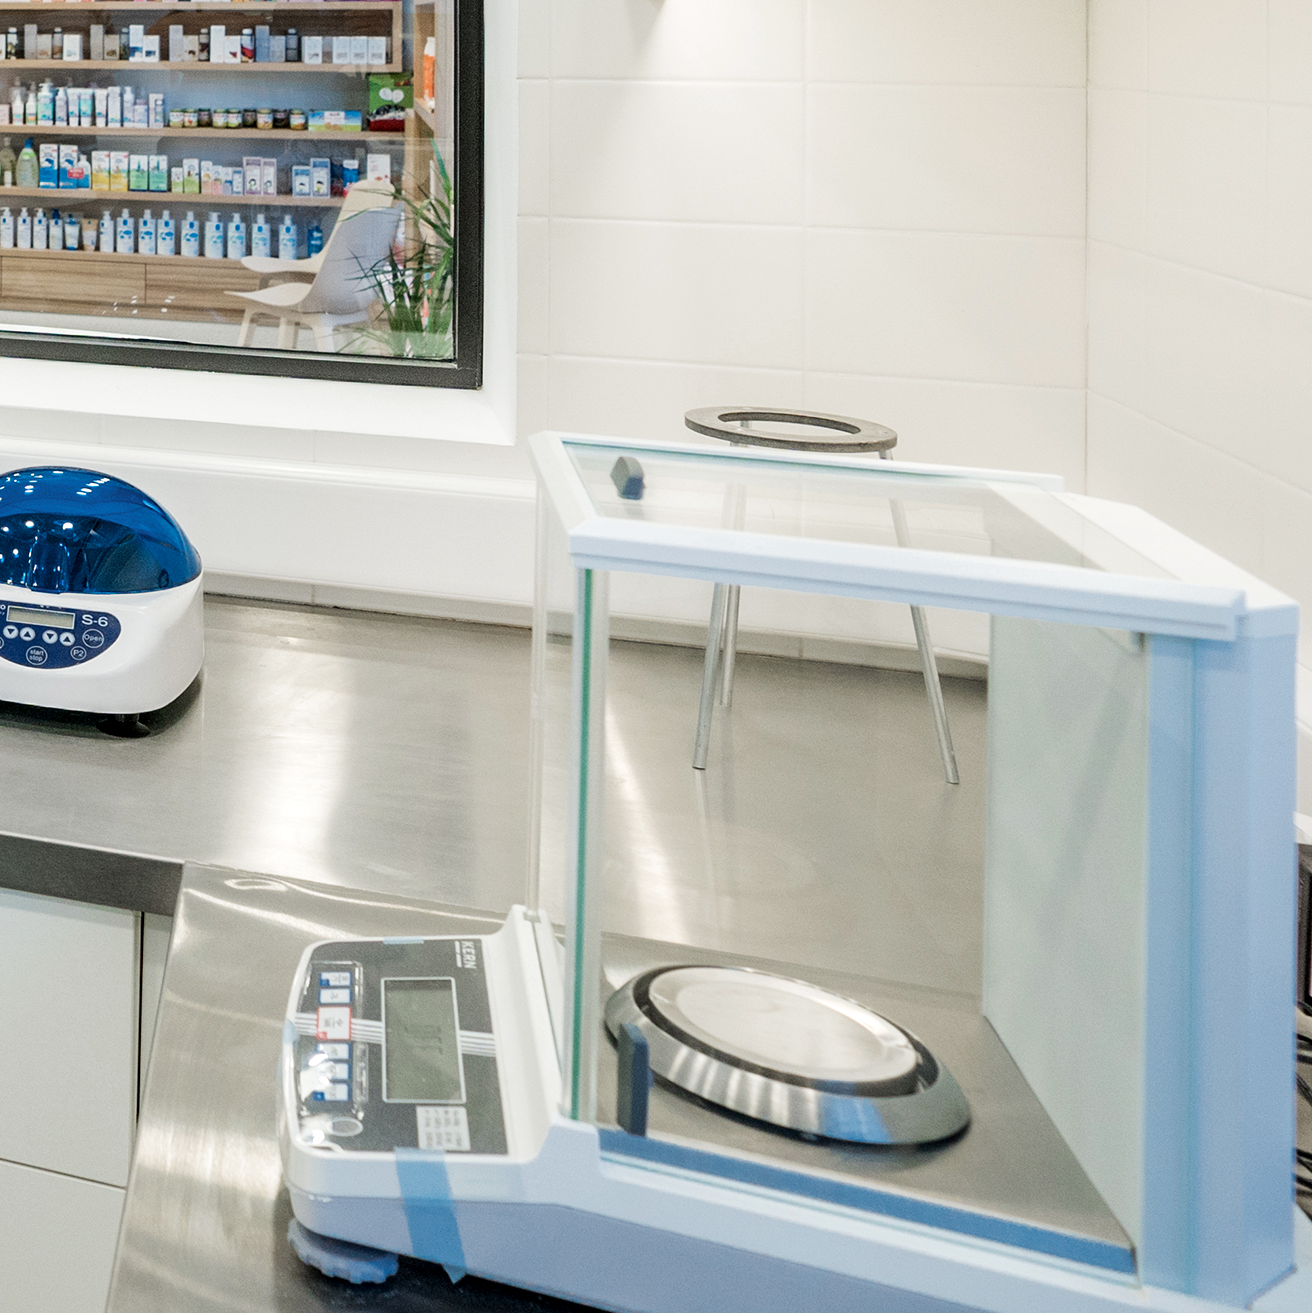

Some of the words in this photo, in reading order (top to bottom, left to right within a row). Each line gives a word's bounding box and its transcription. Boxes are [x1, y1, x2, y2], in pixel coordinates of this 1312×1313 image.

[81, 614, 109, 627] S-6
[73, 649, 84, 657] P2
[461, 941, 477, 969] KERN
